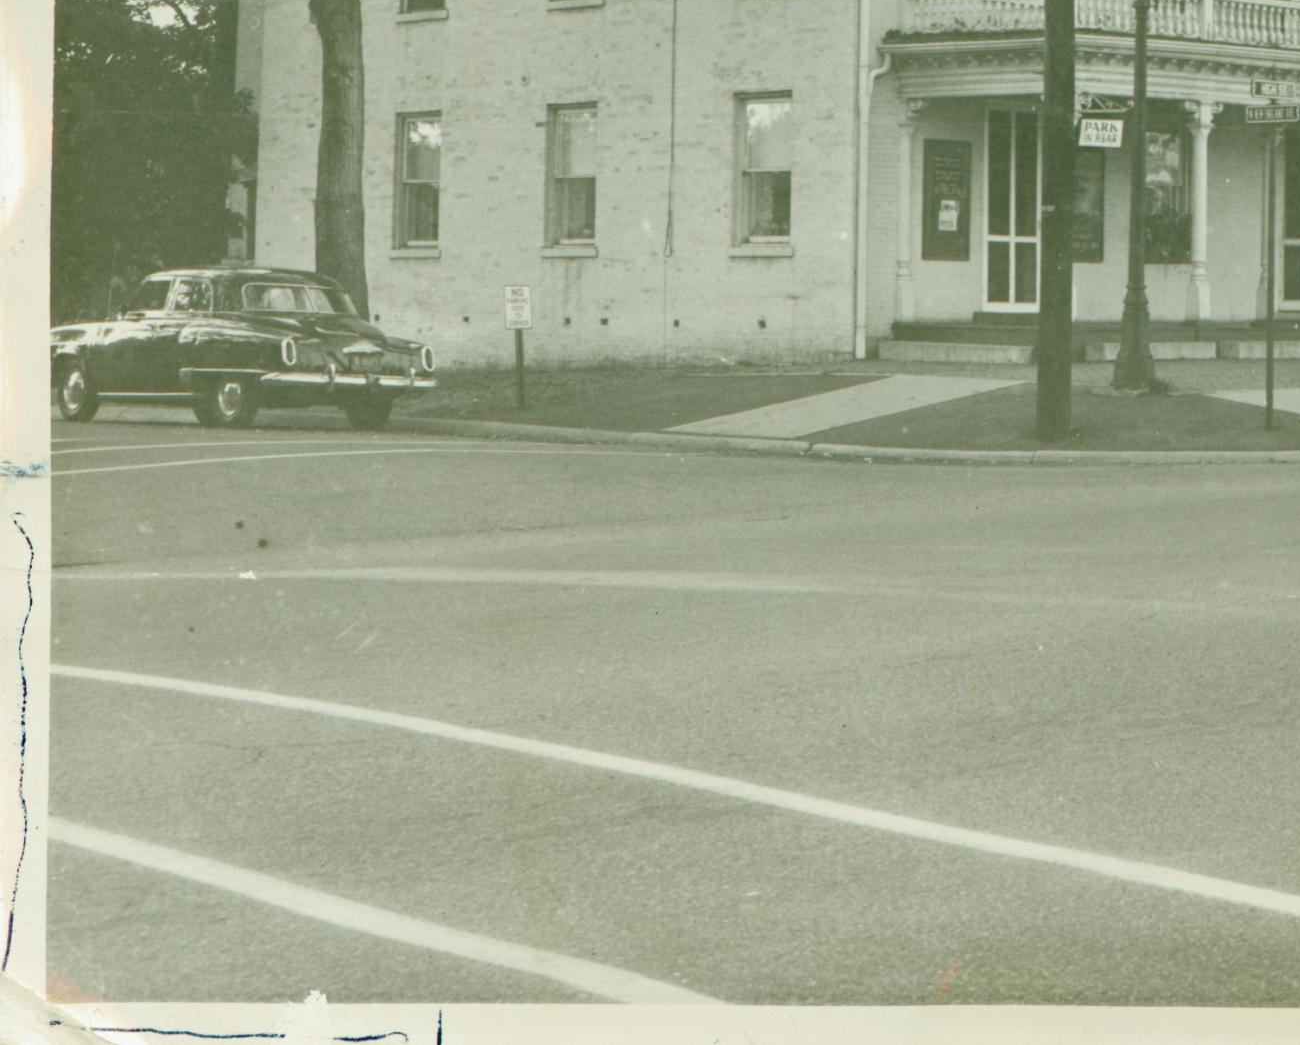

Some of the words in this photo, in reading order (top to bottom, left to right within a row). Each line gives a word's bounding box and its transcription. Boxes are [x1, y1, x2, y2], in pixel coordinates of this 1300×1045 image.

[1084, 121, 1118, 133] PARK
[1083, 133, 1093, 142] IN
[1095, 133, 1117, 143] REAR
[511, 288, 524, 297] NO
